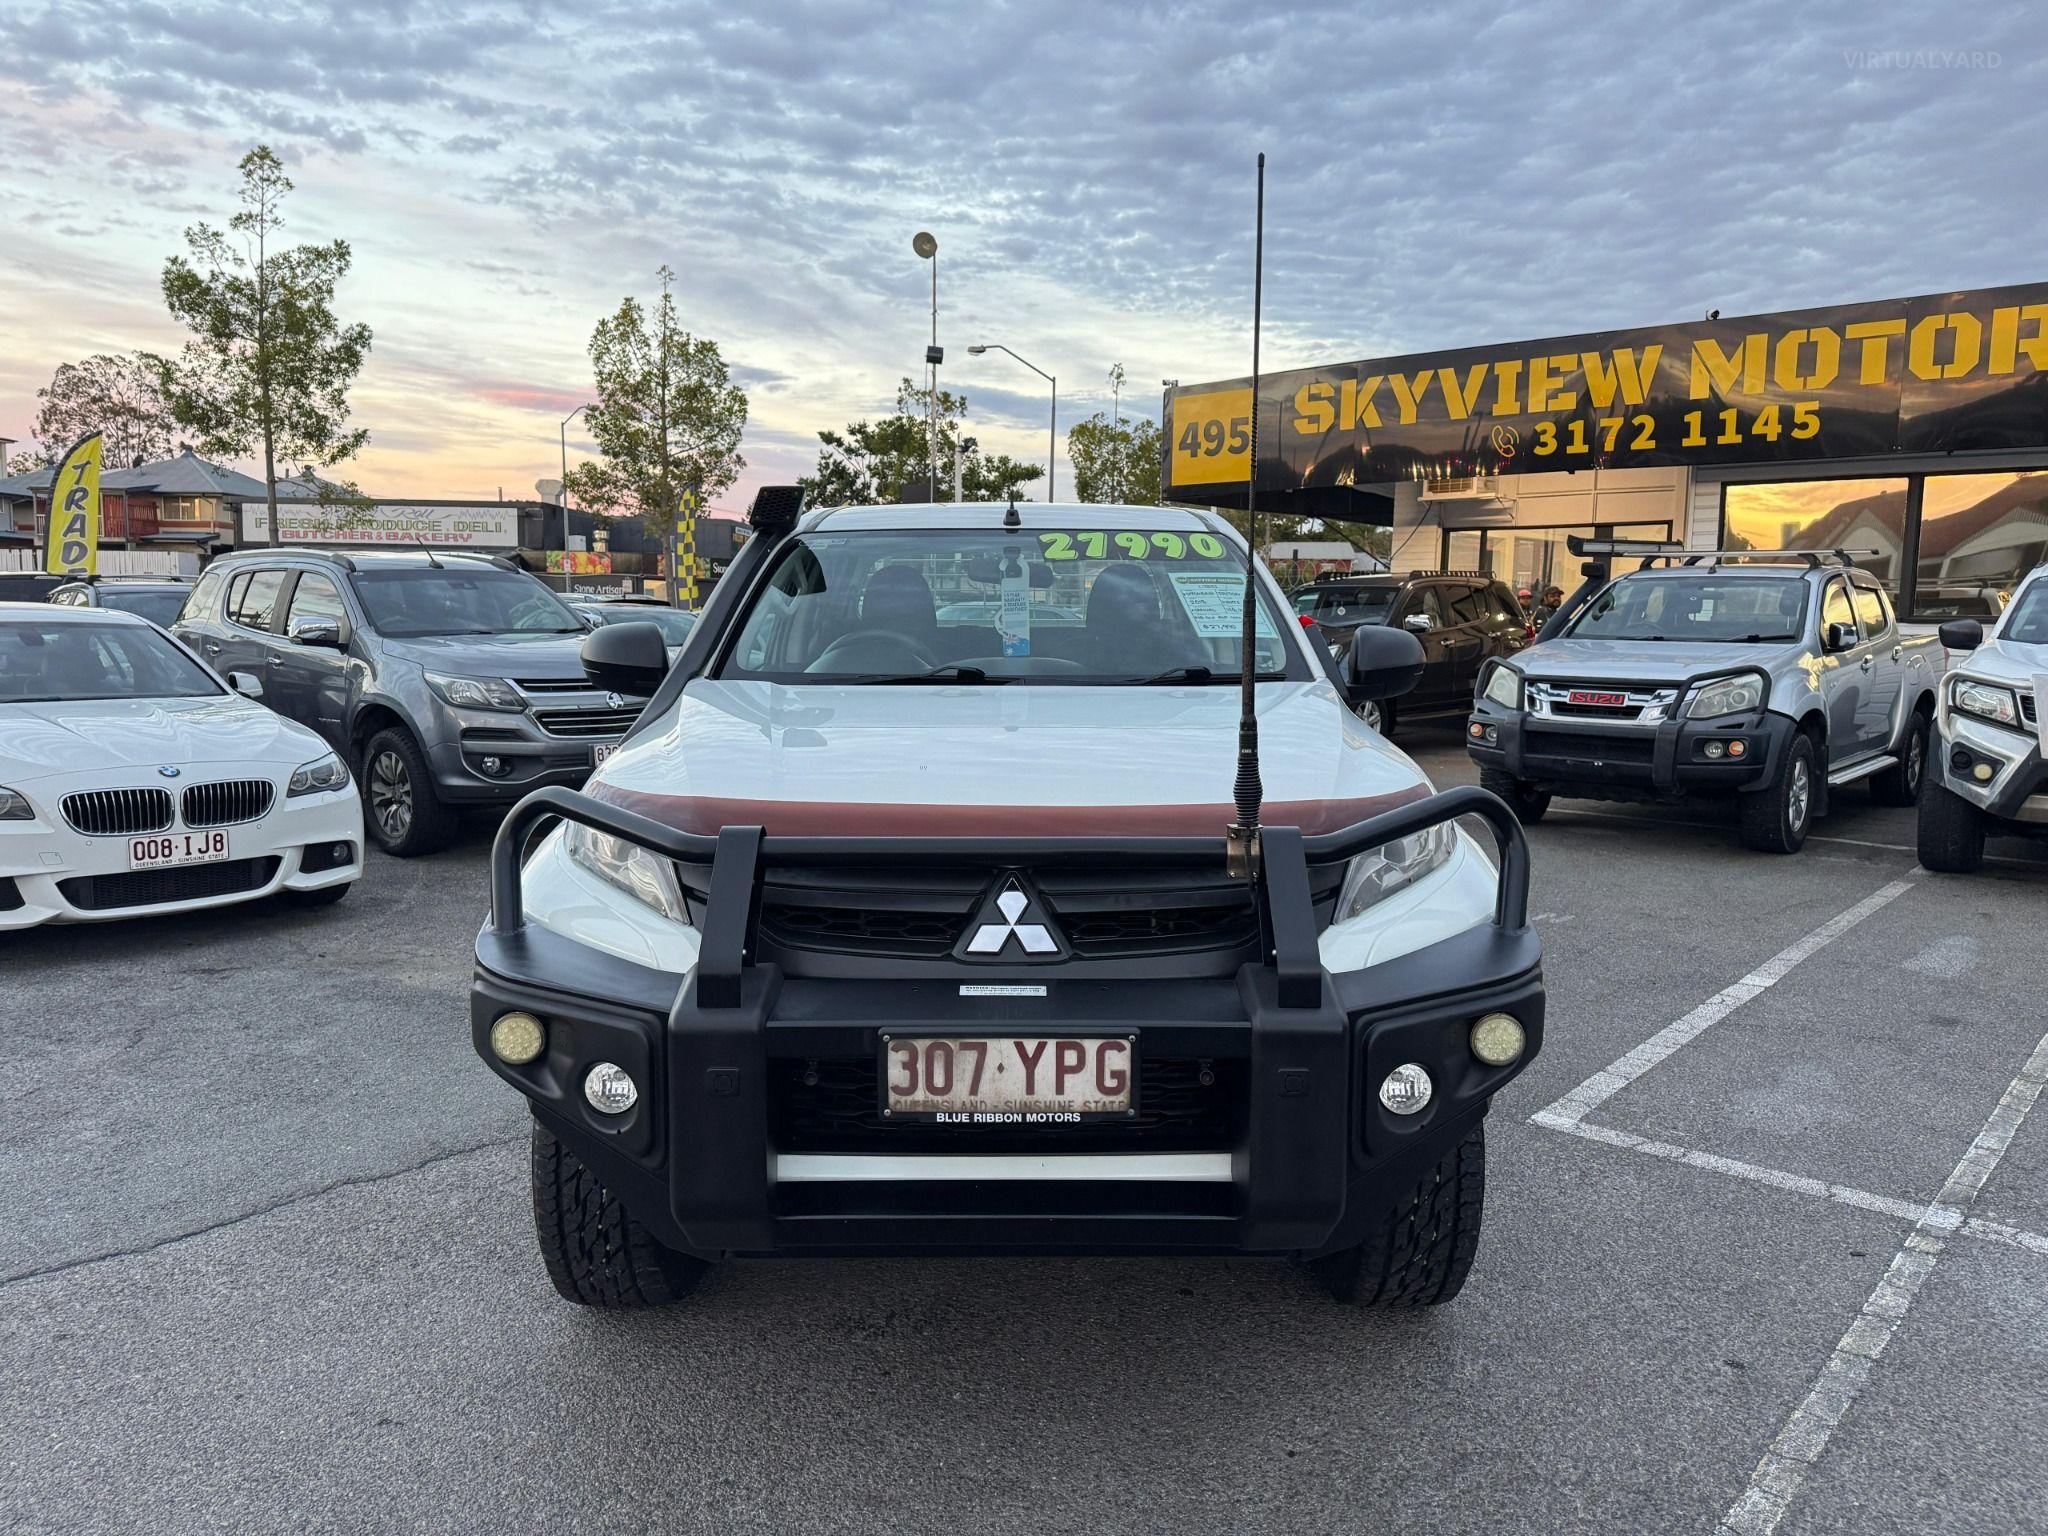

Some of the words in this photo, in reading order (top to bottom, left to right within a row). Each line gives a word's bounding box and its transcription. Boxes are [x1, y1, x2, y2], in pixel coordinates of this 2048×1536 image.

[1293, 343, 1664, 434] SKYVIEW
[1689, 303, 2048, 400] MOTOR
[1178, 415, 1250, 459] 495
[1533, 413, 1656, 456] 3172
[1681, 400, 1821, 448] 1145
[60, 459, 92, 574] TRAD
[282, 529, 373, 540] BUTCHER
[385, 532, 473, 543] BAKERY
[1038, 531, 1227, 560] 27990
[1570, 692, 1624, 705] ISUZU
[936, 1112, 970, 1123] BLUE
[973, 1112, 1024, 1123] RIBBON
[1026, 1112, 1082, 1123] MOTORS
